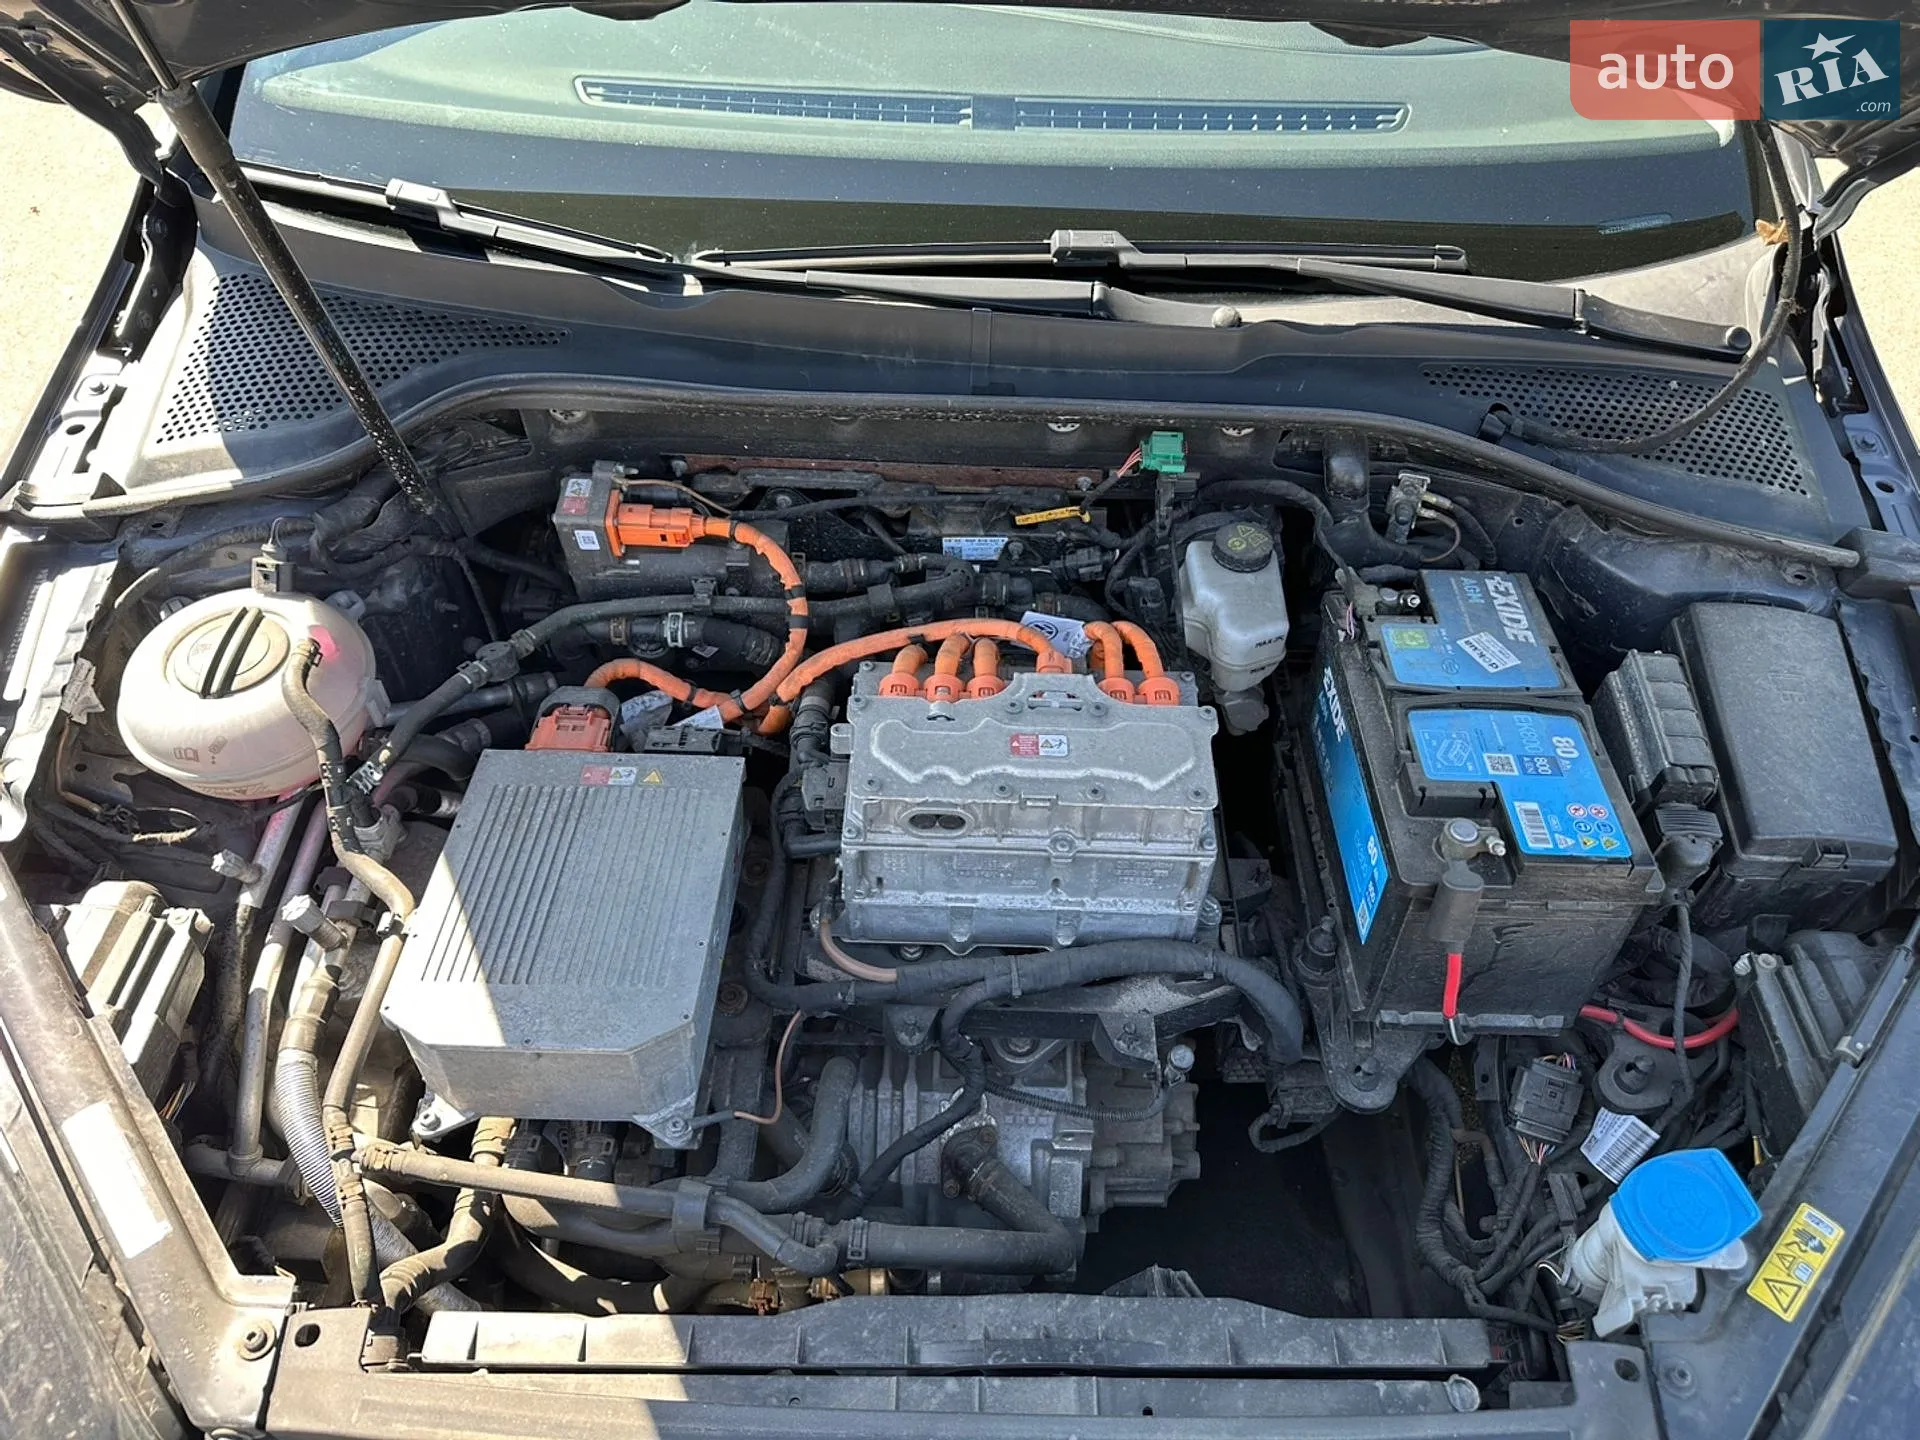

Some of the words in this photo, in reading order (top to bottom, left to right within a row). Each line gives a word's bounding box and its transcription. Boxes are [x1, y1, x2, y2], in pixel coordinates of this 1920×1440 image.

[1484, 576, 1535, 647] EXIDE
[1324, 667, 1347, 741] EXIDE
[1534, 757, 1552, 775] 800
[1551, 736, 1579, 759] 80
